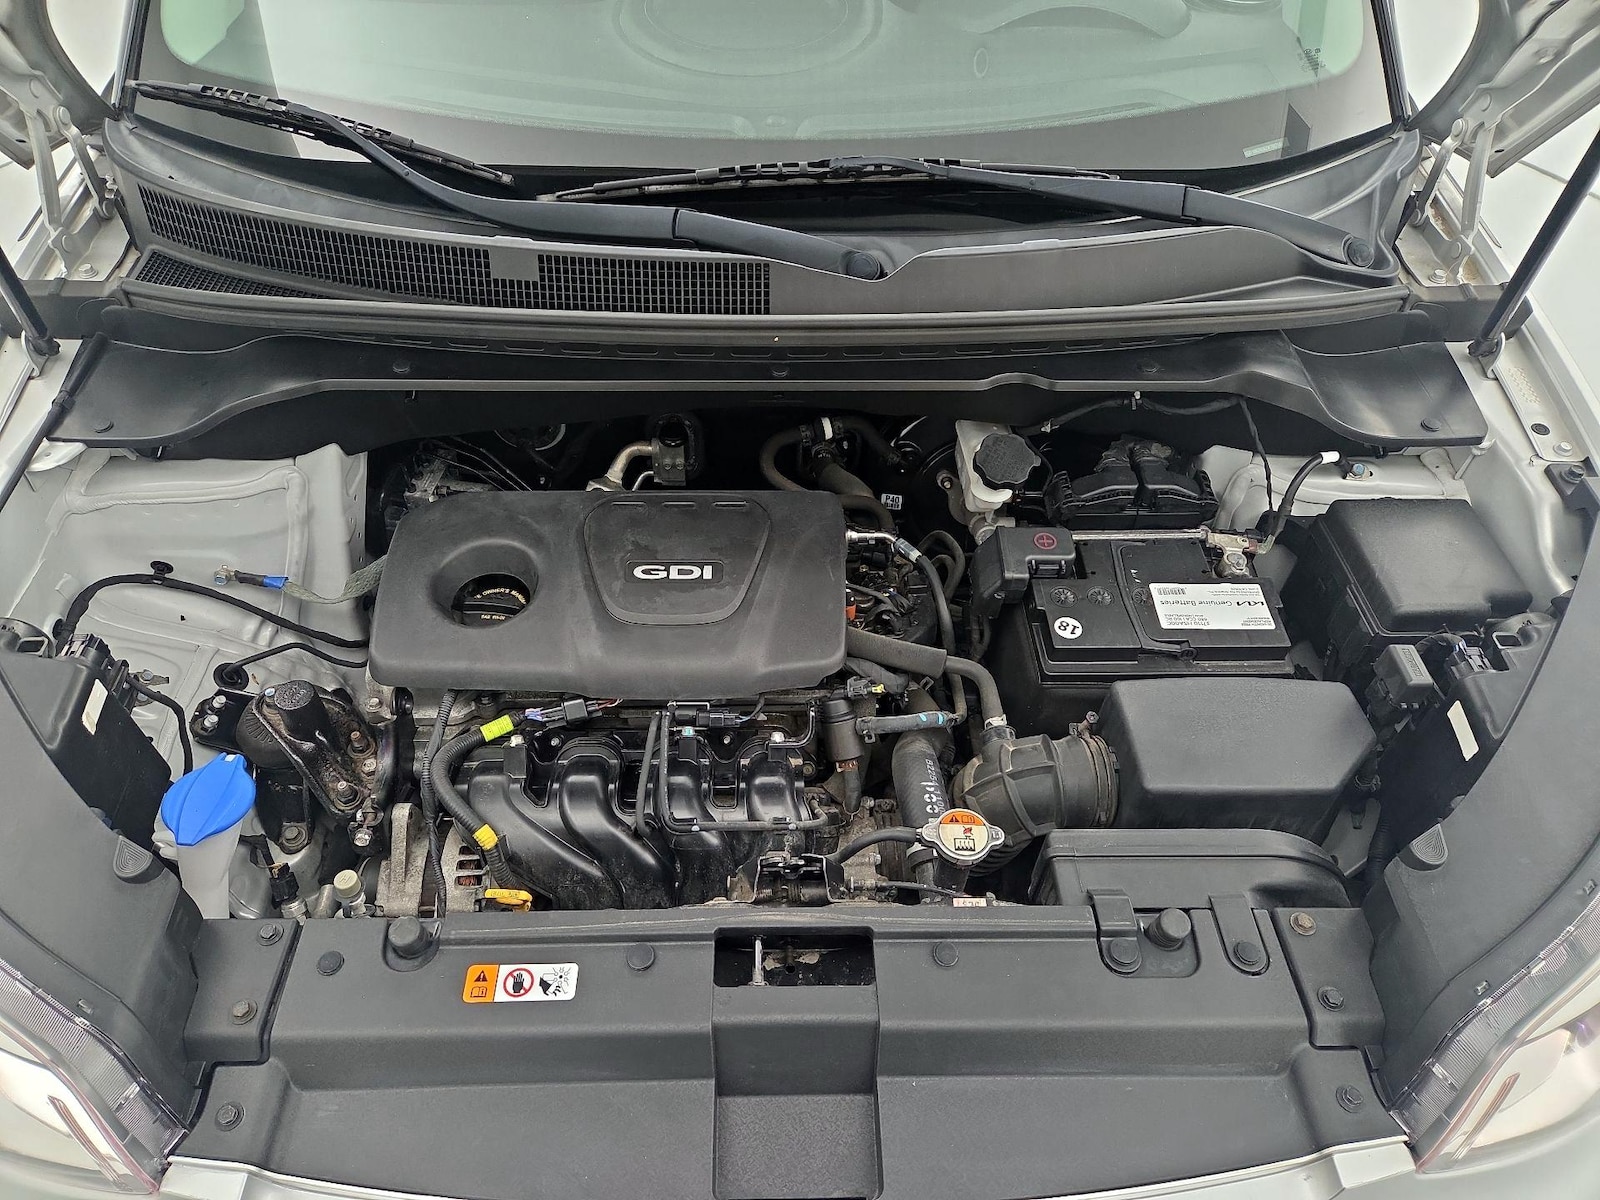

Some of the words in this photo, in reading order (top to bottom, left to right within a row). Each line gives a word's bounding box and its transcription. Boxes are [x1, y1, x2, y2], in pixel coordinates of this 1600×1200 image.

[886, 495, 899, 504] P40
[633, 565, 713, 580] GDI
[1058, 620, 1080, 635] 18
